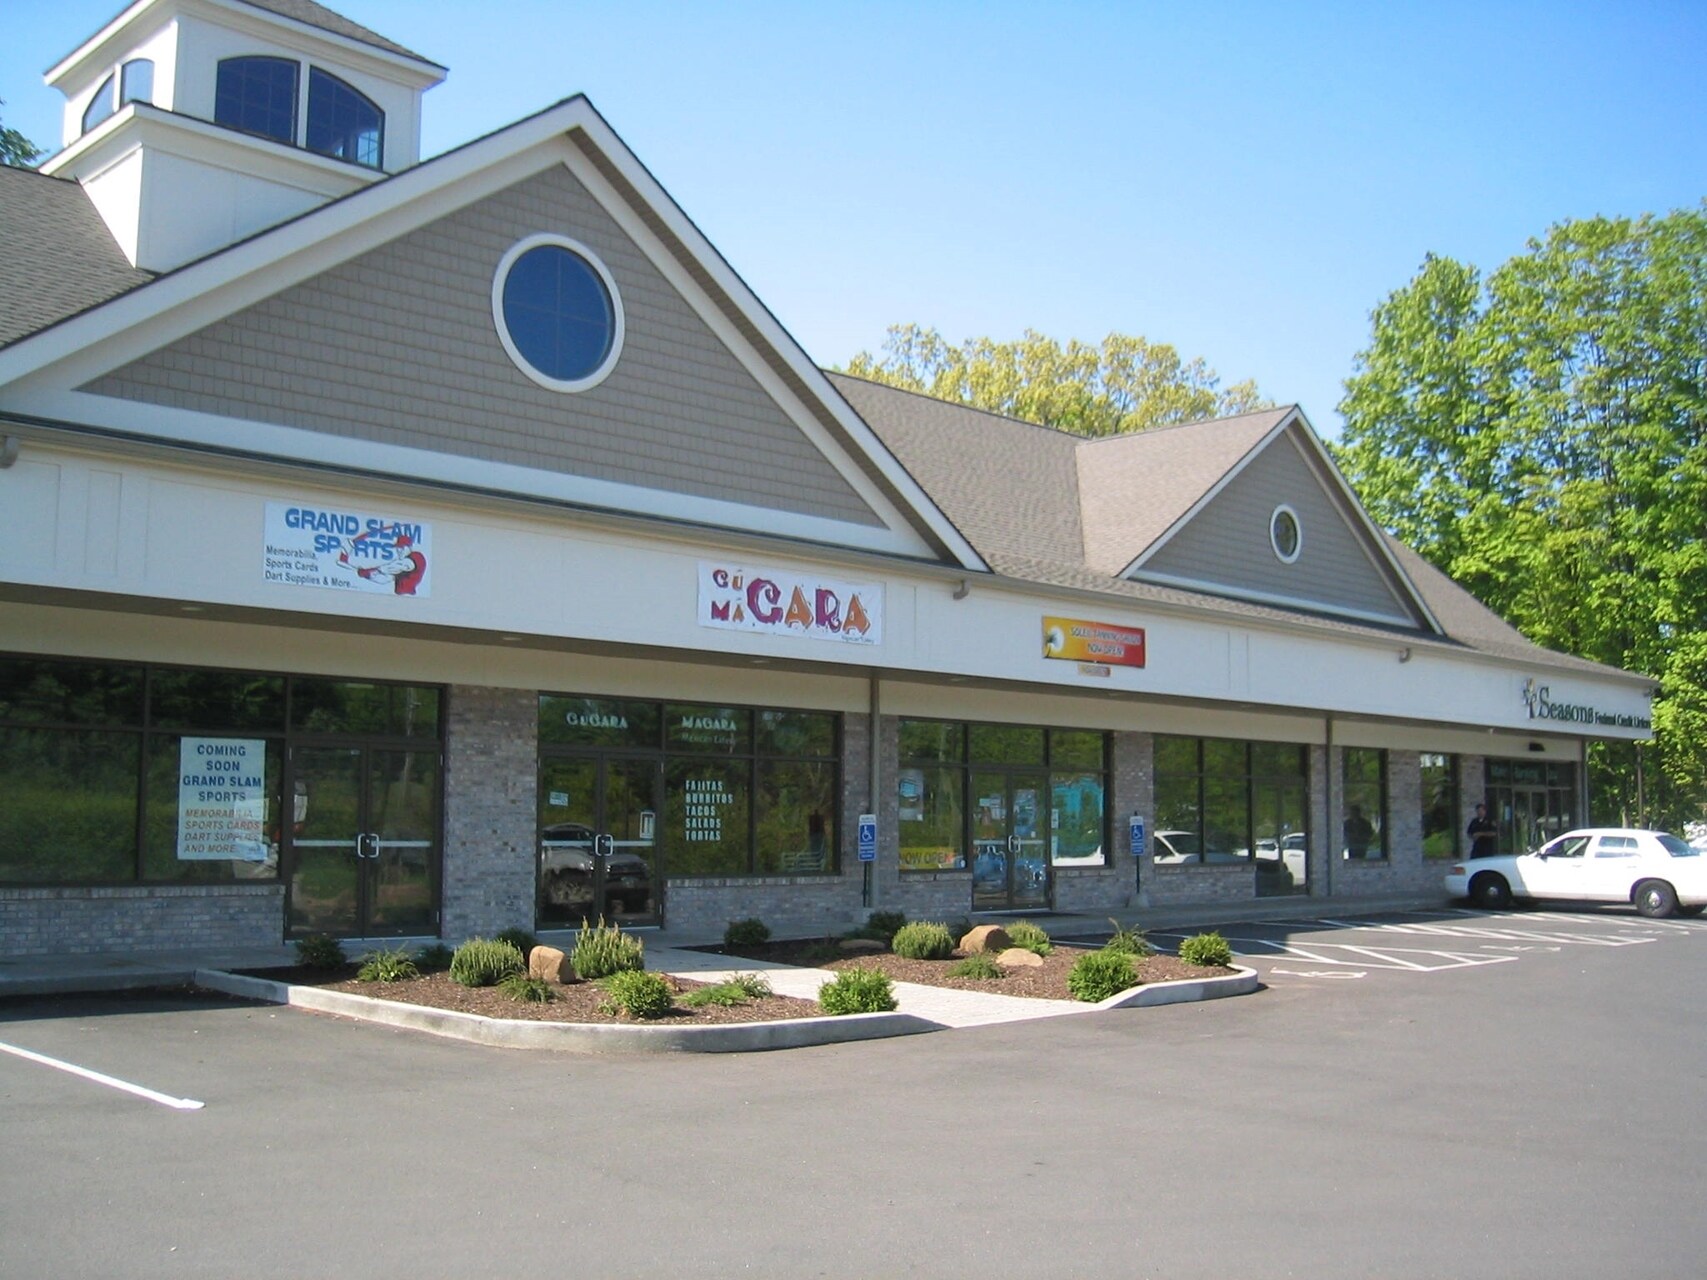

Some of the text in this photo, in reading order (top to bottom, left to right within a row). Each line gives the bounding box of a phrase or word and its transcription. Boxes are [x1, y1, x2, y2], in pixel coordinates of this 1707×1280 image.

[285, 508, 422, 545] GRAND SLAM
[314, 534, 394, 561] SPRTS
[266, 558, 319, 573] Sports Cards
[265, 570, 283, 580] Dart
[285, 572, 321, 585] Supplies
[323, 576, 329, 585] &
[1538, 686, 1594, 724] Seasons
[197, 744, 246, 757] COMING
[206, 760, 240, 772] SOON
[183, 775, 262, 788] GRAND SLAM
[686, 780, 723, 791] FAJITAS
[198, 791, 246, 803] SPORTS
[686, 793, 733, 804] BURRITOS
[686, 805, 716, 817] TACOS
[185, 820, 260, 830] SPORTS CARDS
[686, 818, 721, 828] SALADS
[185, 832, 212, 842] DART
[686, 830, 721, 841] TORTAS
[184, 844, 237, 853] AND MORE
